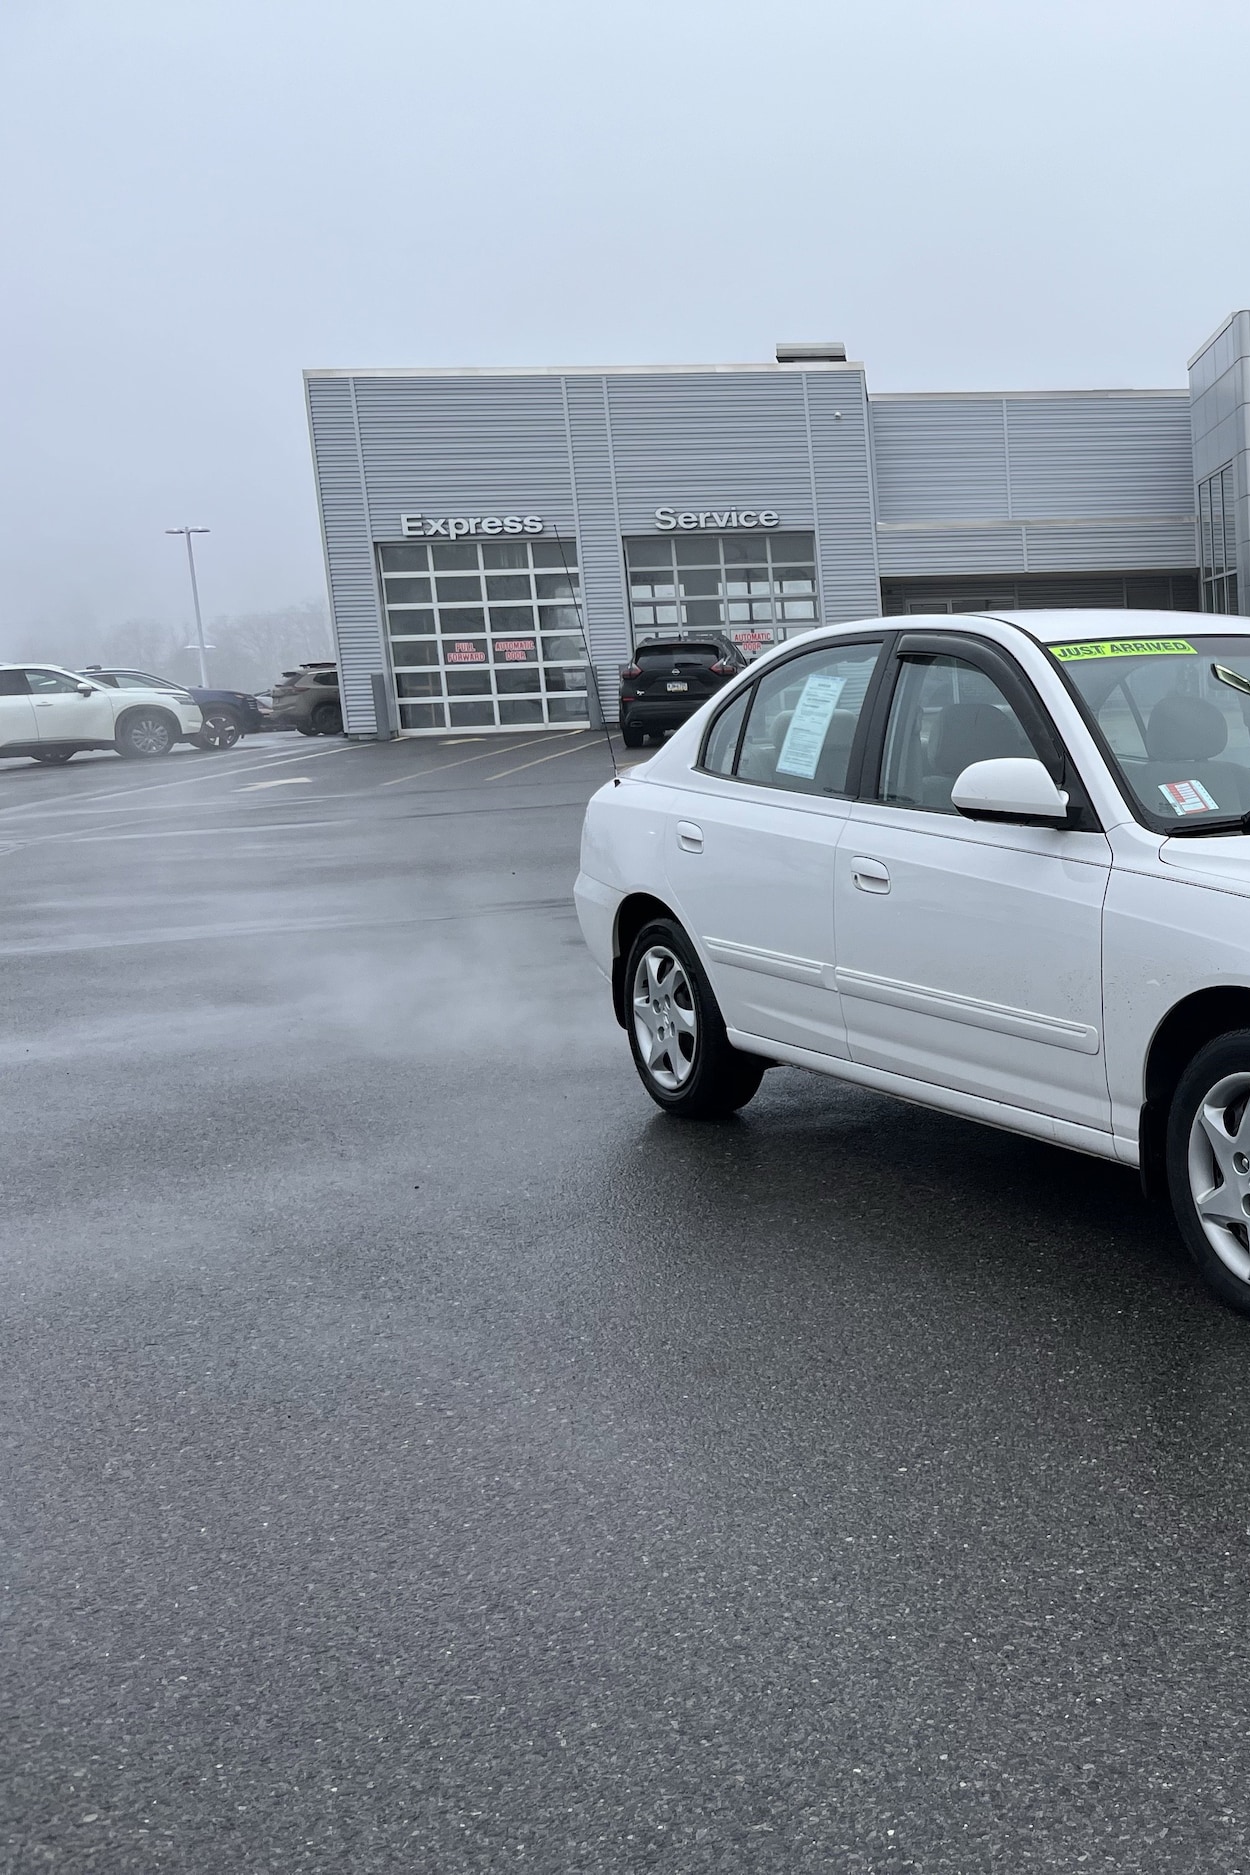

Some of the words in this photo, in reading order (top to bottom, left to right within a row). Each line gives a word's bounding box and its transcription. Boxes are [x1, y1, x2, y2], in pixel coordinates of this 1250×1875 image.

[655, 506, 779, 530] Service
[400, 513, 544, 540] Express
[734, 632, 772, 641] AUTOMATIC
[455, 643, 476, 652] PULL
[495, 640, 535, 651] AUTOMATIC
[743, 641, 762, 650] DOOR
[1058, 645, 1103, 658] JUST
[1110, 641, 1188, 653] ARRIVED
[447, 652, 486, 662] FORWARD
[505, 651, 526, 661] DOOR
